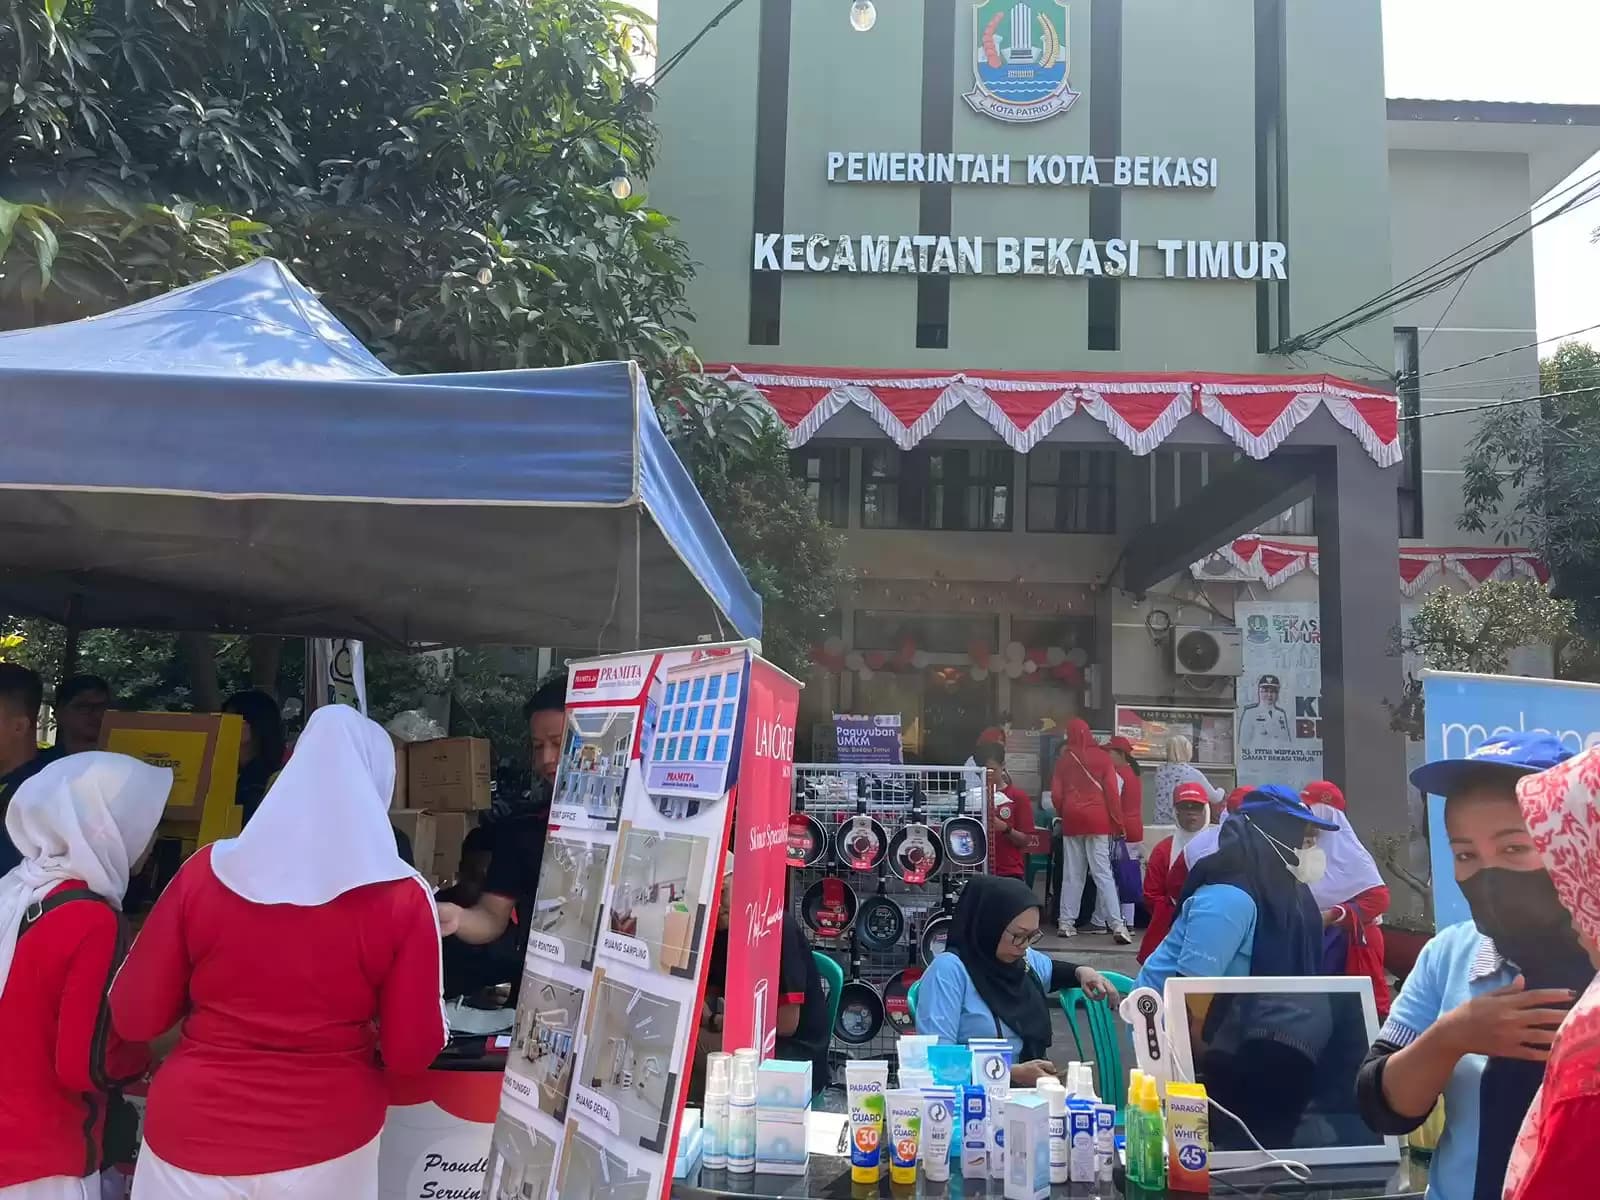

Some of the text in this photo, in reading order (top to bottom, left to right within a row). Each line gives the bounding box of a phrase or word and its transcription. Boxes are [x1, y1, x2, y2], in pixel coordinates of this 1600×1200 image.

[990, 102, 1054, 116] KOTA PATRIOT
[827, 151, 1218, 189] PEMERINTAH KOTA BEKASI
[754, 233, 1288, 281] KECAMATAN BEKASI TIMUR
[1272, 619, 1321, 632] BEKAS
[600, 664, 641, 681] PRAMITA
[1295, 696, 1321, 718] K
[836, 726, 896, 737] Paguyuban
[1295, 719, 1321, 739] B
[836, 736, 870, 746] UMKM
[604, 938, 647, 960] RUANG SAMPLING
[849, 1082, 881, 1092] PARASOL
[576, 1093, 611, 1121] RUANG DENTAL
[892, 1108, 919, 1117] PARASOL
[1170, 1102, 1206, 1113] PARASOL
[852, 1113, 881, 1122] GUARD
[859, 1129, 878, 1145] 30
[893, 1129, 918, 1137] GUARD
[1174, 1129, 1203, 1140] WHITE
[900, 1142, 917, 1154] 30
[424, 1153, 489, 1173] Proudl
[419, 1181, 482, 1200] Servin
